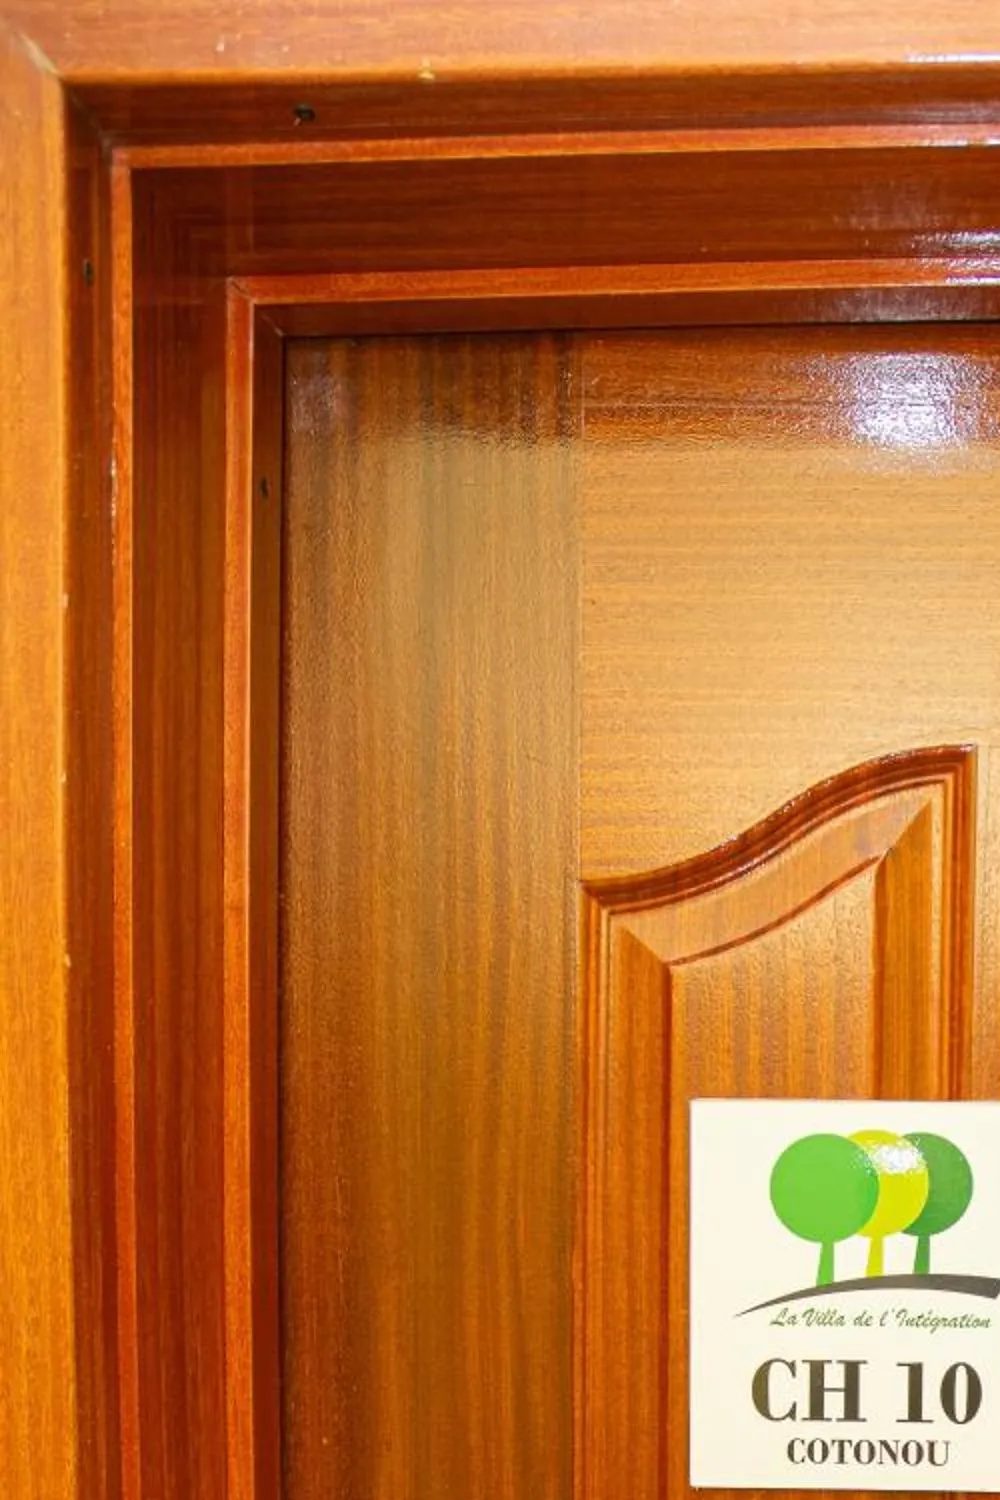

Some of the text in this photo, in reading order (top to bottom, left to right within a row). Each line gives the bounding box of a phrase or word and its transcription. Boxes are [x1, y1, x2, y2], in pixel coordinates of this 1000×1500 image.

[770, 1307, 798, 1327] La
[804, 1307, 846, 1328] Villa
[853, 1308, 874, 1327] de
[751, 1358, 983, 1425] CH 10
[786, 1437, 950, 1467] COTONOU
